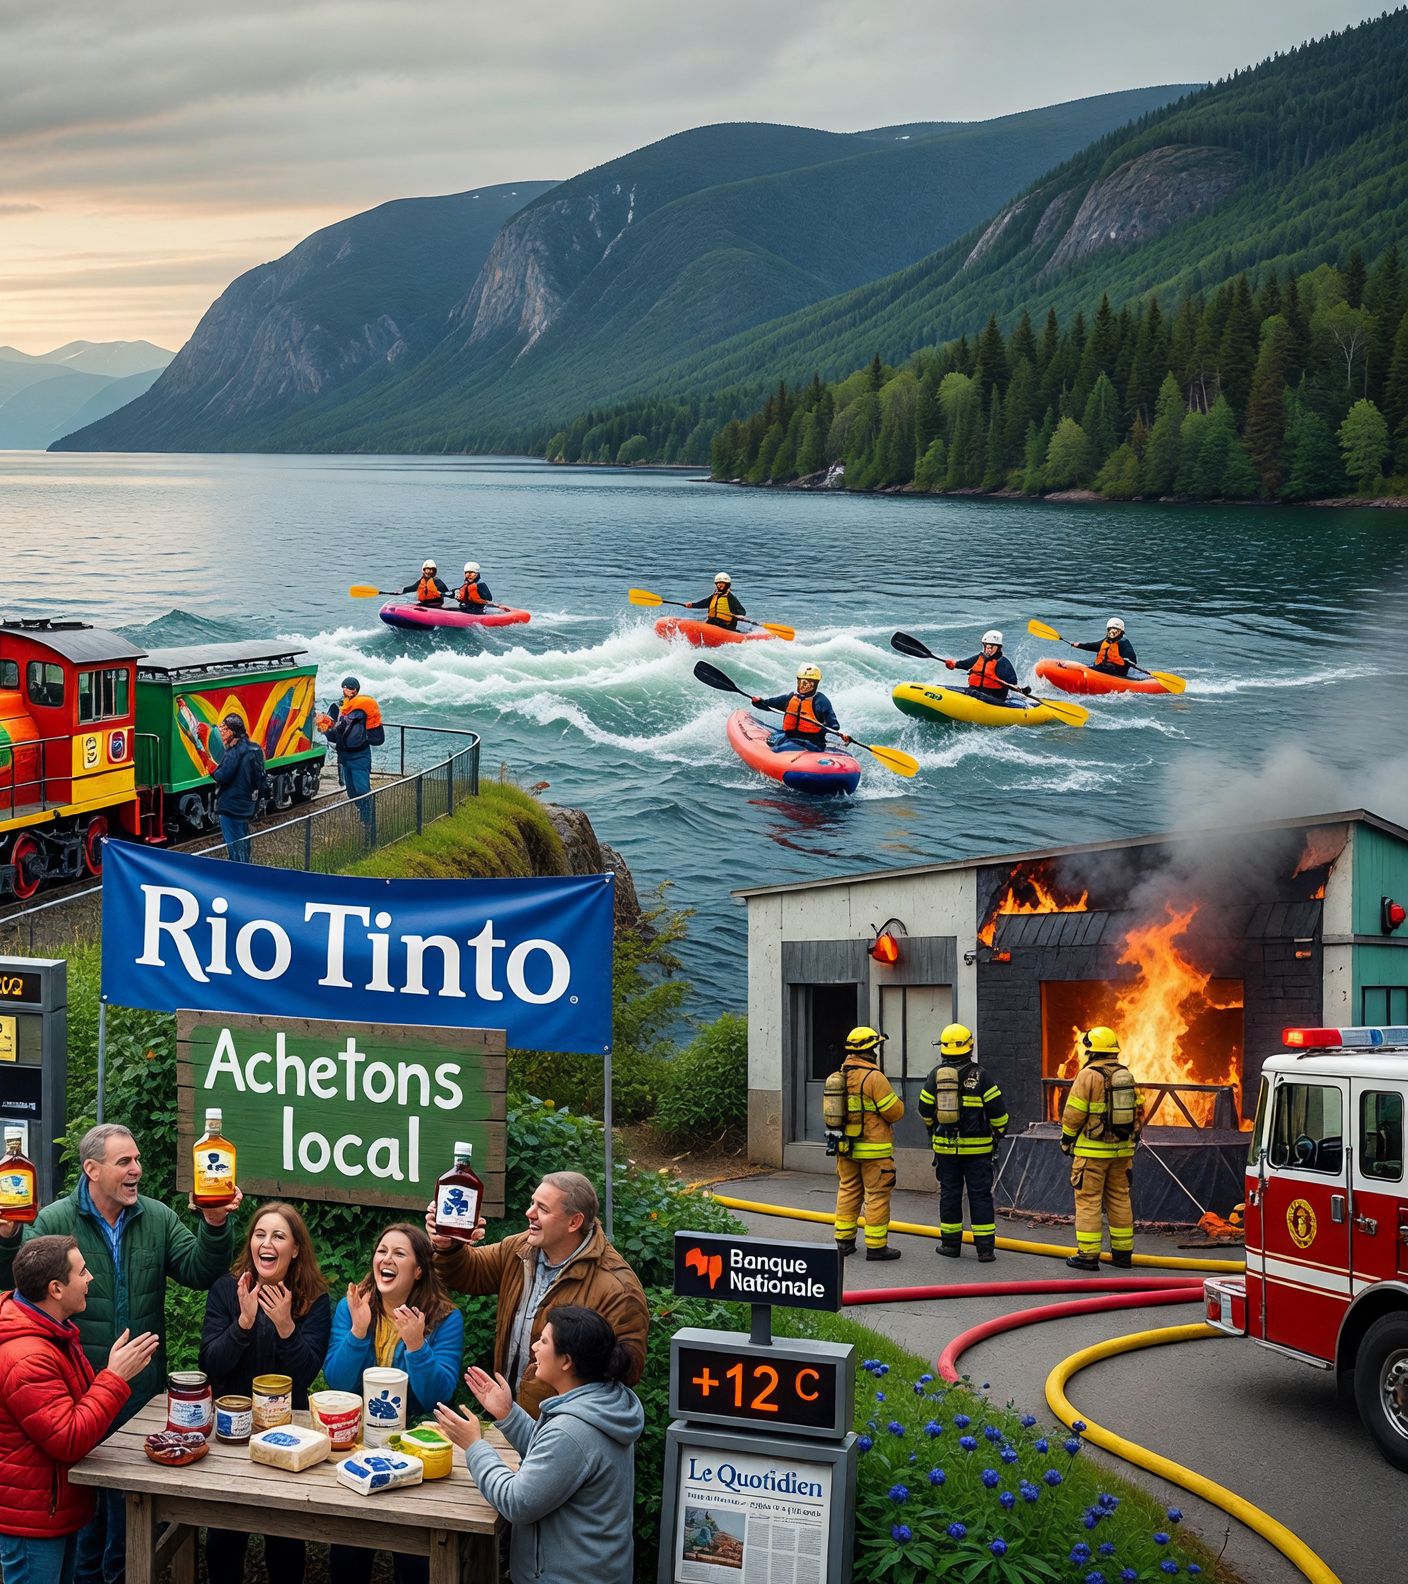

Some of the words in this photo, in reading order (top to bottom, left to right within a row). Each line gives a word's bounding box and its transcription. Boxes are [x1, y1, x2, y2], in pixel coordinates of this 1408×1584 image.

[134, 883, 293, 984] Rio
[303, 901, 572, 1005] Tinto
[203, 1028, 464, 1111] Achetons
[282, 1105, 421, 1184] local
[730, 1248, 808, 1278] Banque
[730, 1270, 825, 1298] Nationale
[692, 1363, 779, 1412] +12
[795, 1368, 820, 1401] C
[688, 1458, 713, 1482] Le
[717, 1463, 823, 1498] Quotidien
